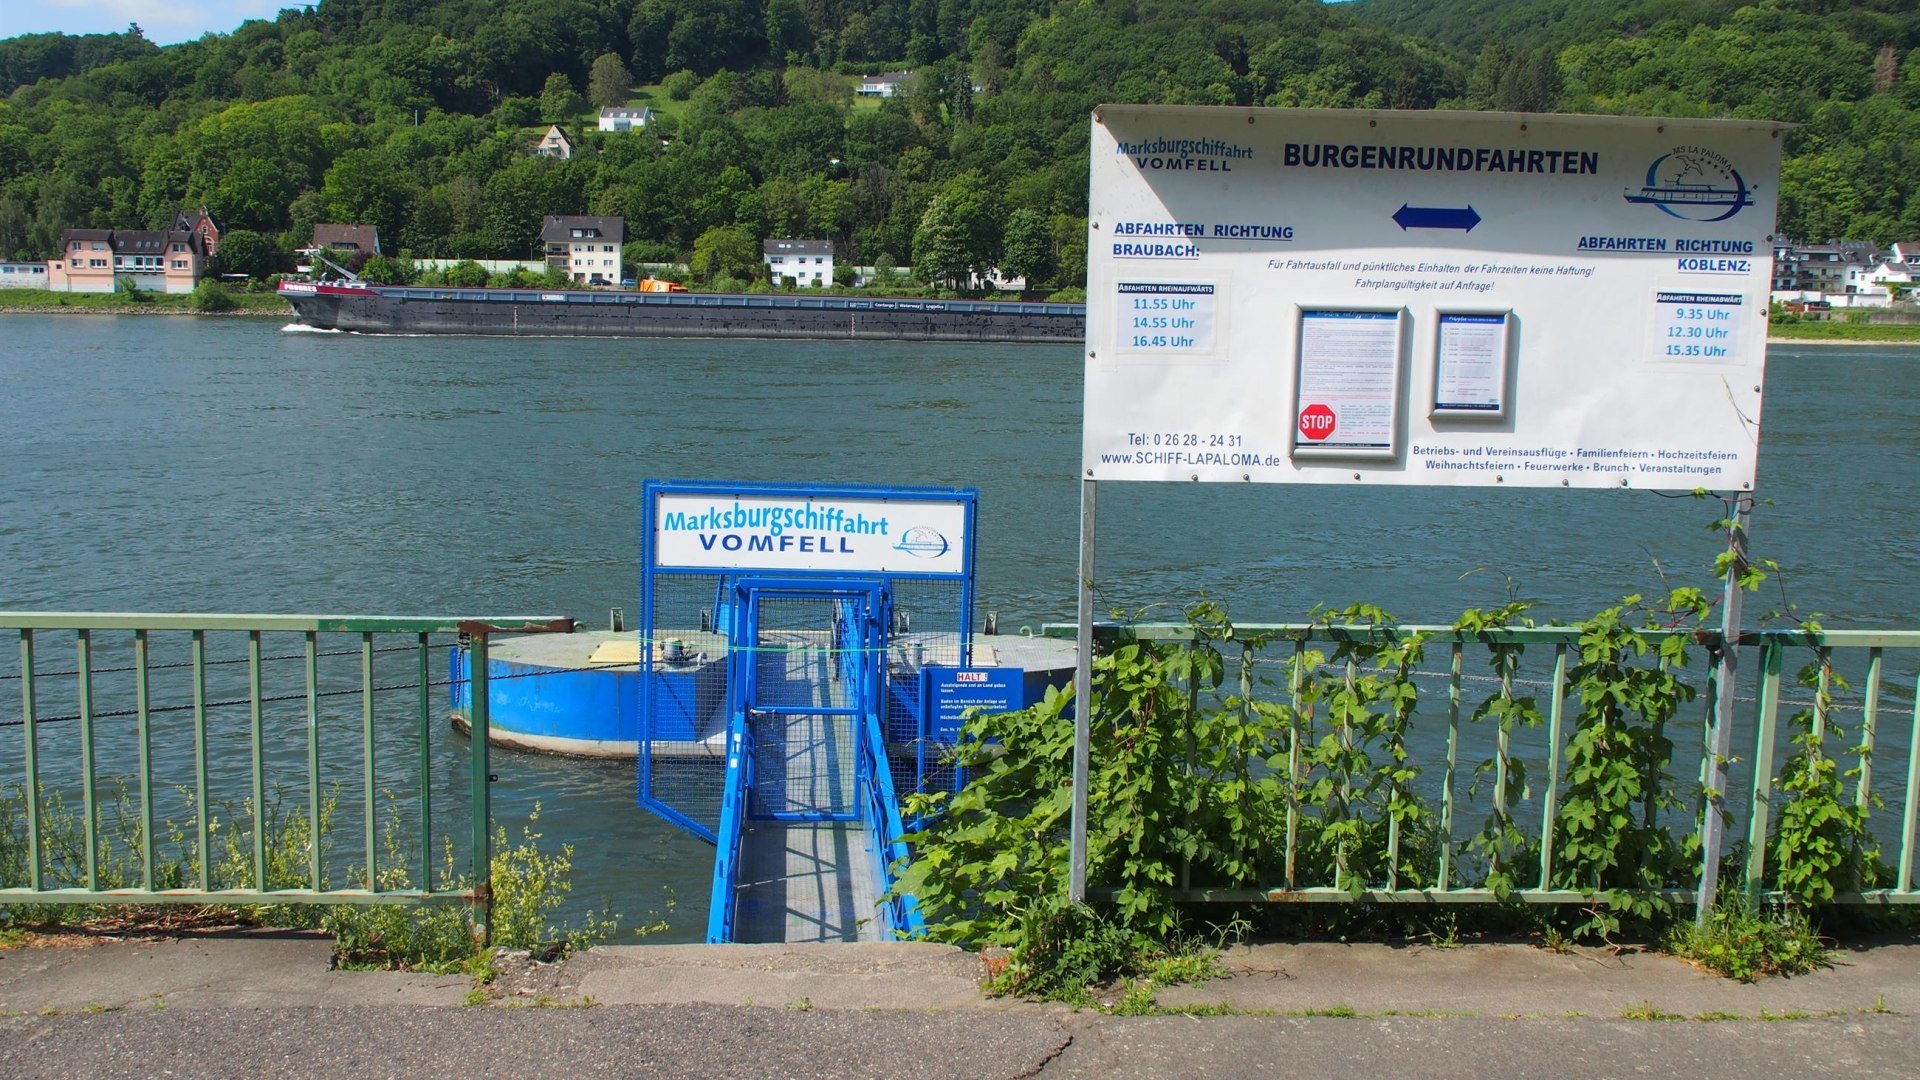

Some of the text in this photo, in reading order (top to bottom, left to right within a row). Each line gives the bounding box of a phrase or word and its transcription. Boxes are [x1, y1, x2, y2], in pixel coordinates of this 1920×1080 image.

[1116, 136, 1252, 159] Marksburgschiffahrt
[1136, 158, 1232, 172] VOMFELL
[1284, 143, 1598, 174] BURGENRUNDFAHRTEN
[1672, 146, 1732, 170] MS LA PALOMA
[1114, 222, 1294, 239] ABFAHRTEN RICHTUNG
[1113, 244, 1200, 257] BRAUBACH:
[1578, 236, 1753, 253] ABFAHRTEN RICHTUNG
[1268, 260, 1595, 277] Für Fahrtausfall und pünktliches Einhalten der Fahrzeiten keine Haftung!
[1678, 258, 1751, 272] KOBLENZ:
[1355, 278, 1494, 292] Fahrplangültigkeit auf Anfrage!
[1134, 298, 1195, 310] 11.55 Uhr
[1676, 308, 1730, 320] 9.35 Uhr
[1133, 317, 1195, 328] 14.55 Uhr
[1668, 327, 1728, 338] 12.30 Uhr
[1132, 336, 1194, 347] 16.45 Uhr
[1666, 345, 1726, 356] 15.35 Uhr
[1302, 414, 1332, 429] STOP
[1128, 433, 1149, 446] Tel:
[1154, 434, 1161, 445] 0
[1165, 434, 1179, 445] 26
[1184, 434, 1197, 446] 28
[1210, 435, 1224, 446] 24
[1228, 435, 1242, 447] 31
[1101, 452, 1280, 466] www.SCHIFF-LAPALOMA.de
[1413, 446, 1737, 460] Betriebs- und Vereinsausflüge Familienfeiern Hochzeitsfeiern
[1426, 460, 1722, 475] Weihnachtsfeiern Feuerwerke Brunch Veranstaltungen
[664, 502, 888, 537] Marksburgschiffahrt
[699, 534, 855, 553] VOMFELL
